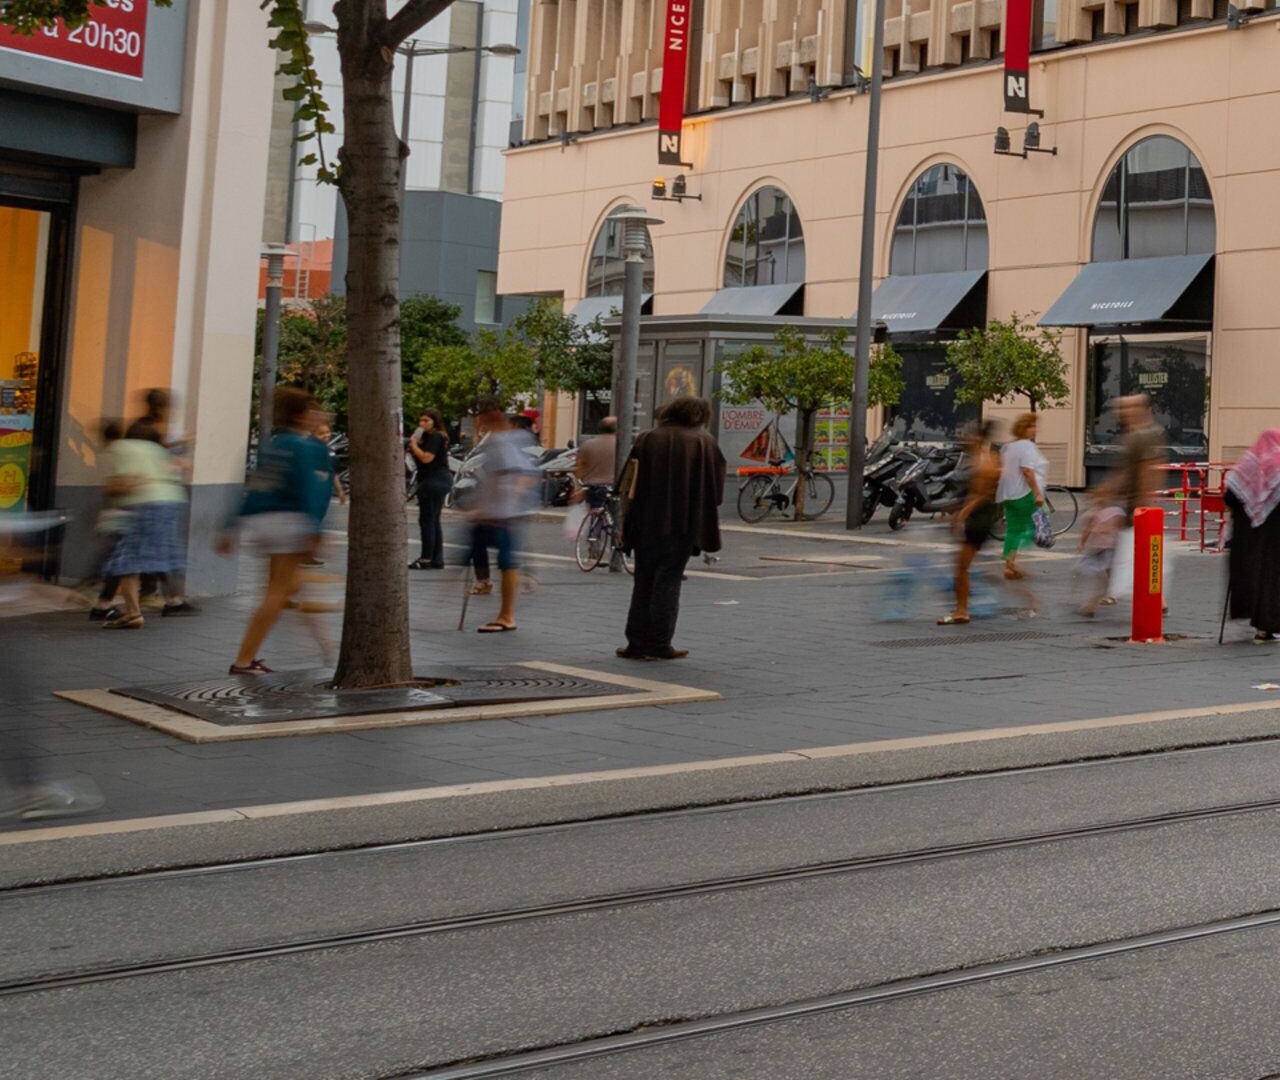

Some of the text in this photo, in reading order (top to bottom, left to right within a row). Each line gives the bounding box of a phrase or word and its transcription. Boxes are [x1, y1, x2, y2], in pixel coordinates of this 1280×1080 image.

[68, 20, 140, 57] 20h30
[1139, 372, 1168, 385] HOLLISTER
[722, 410, 765, 420] L'OMBRE
[724, 420, 762, 430] D'EMILY
